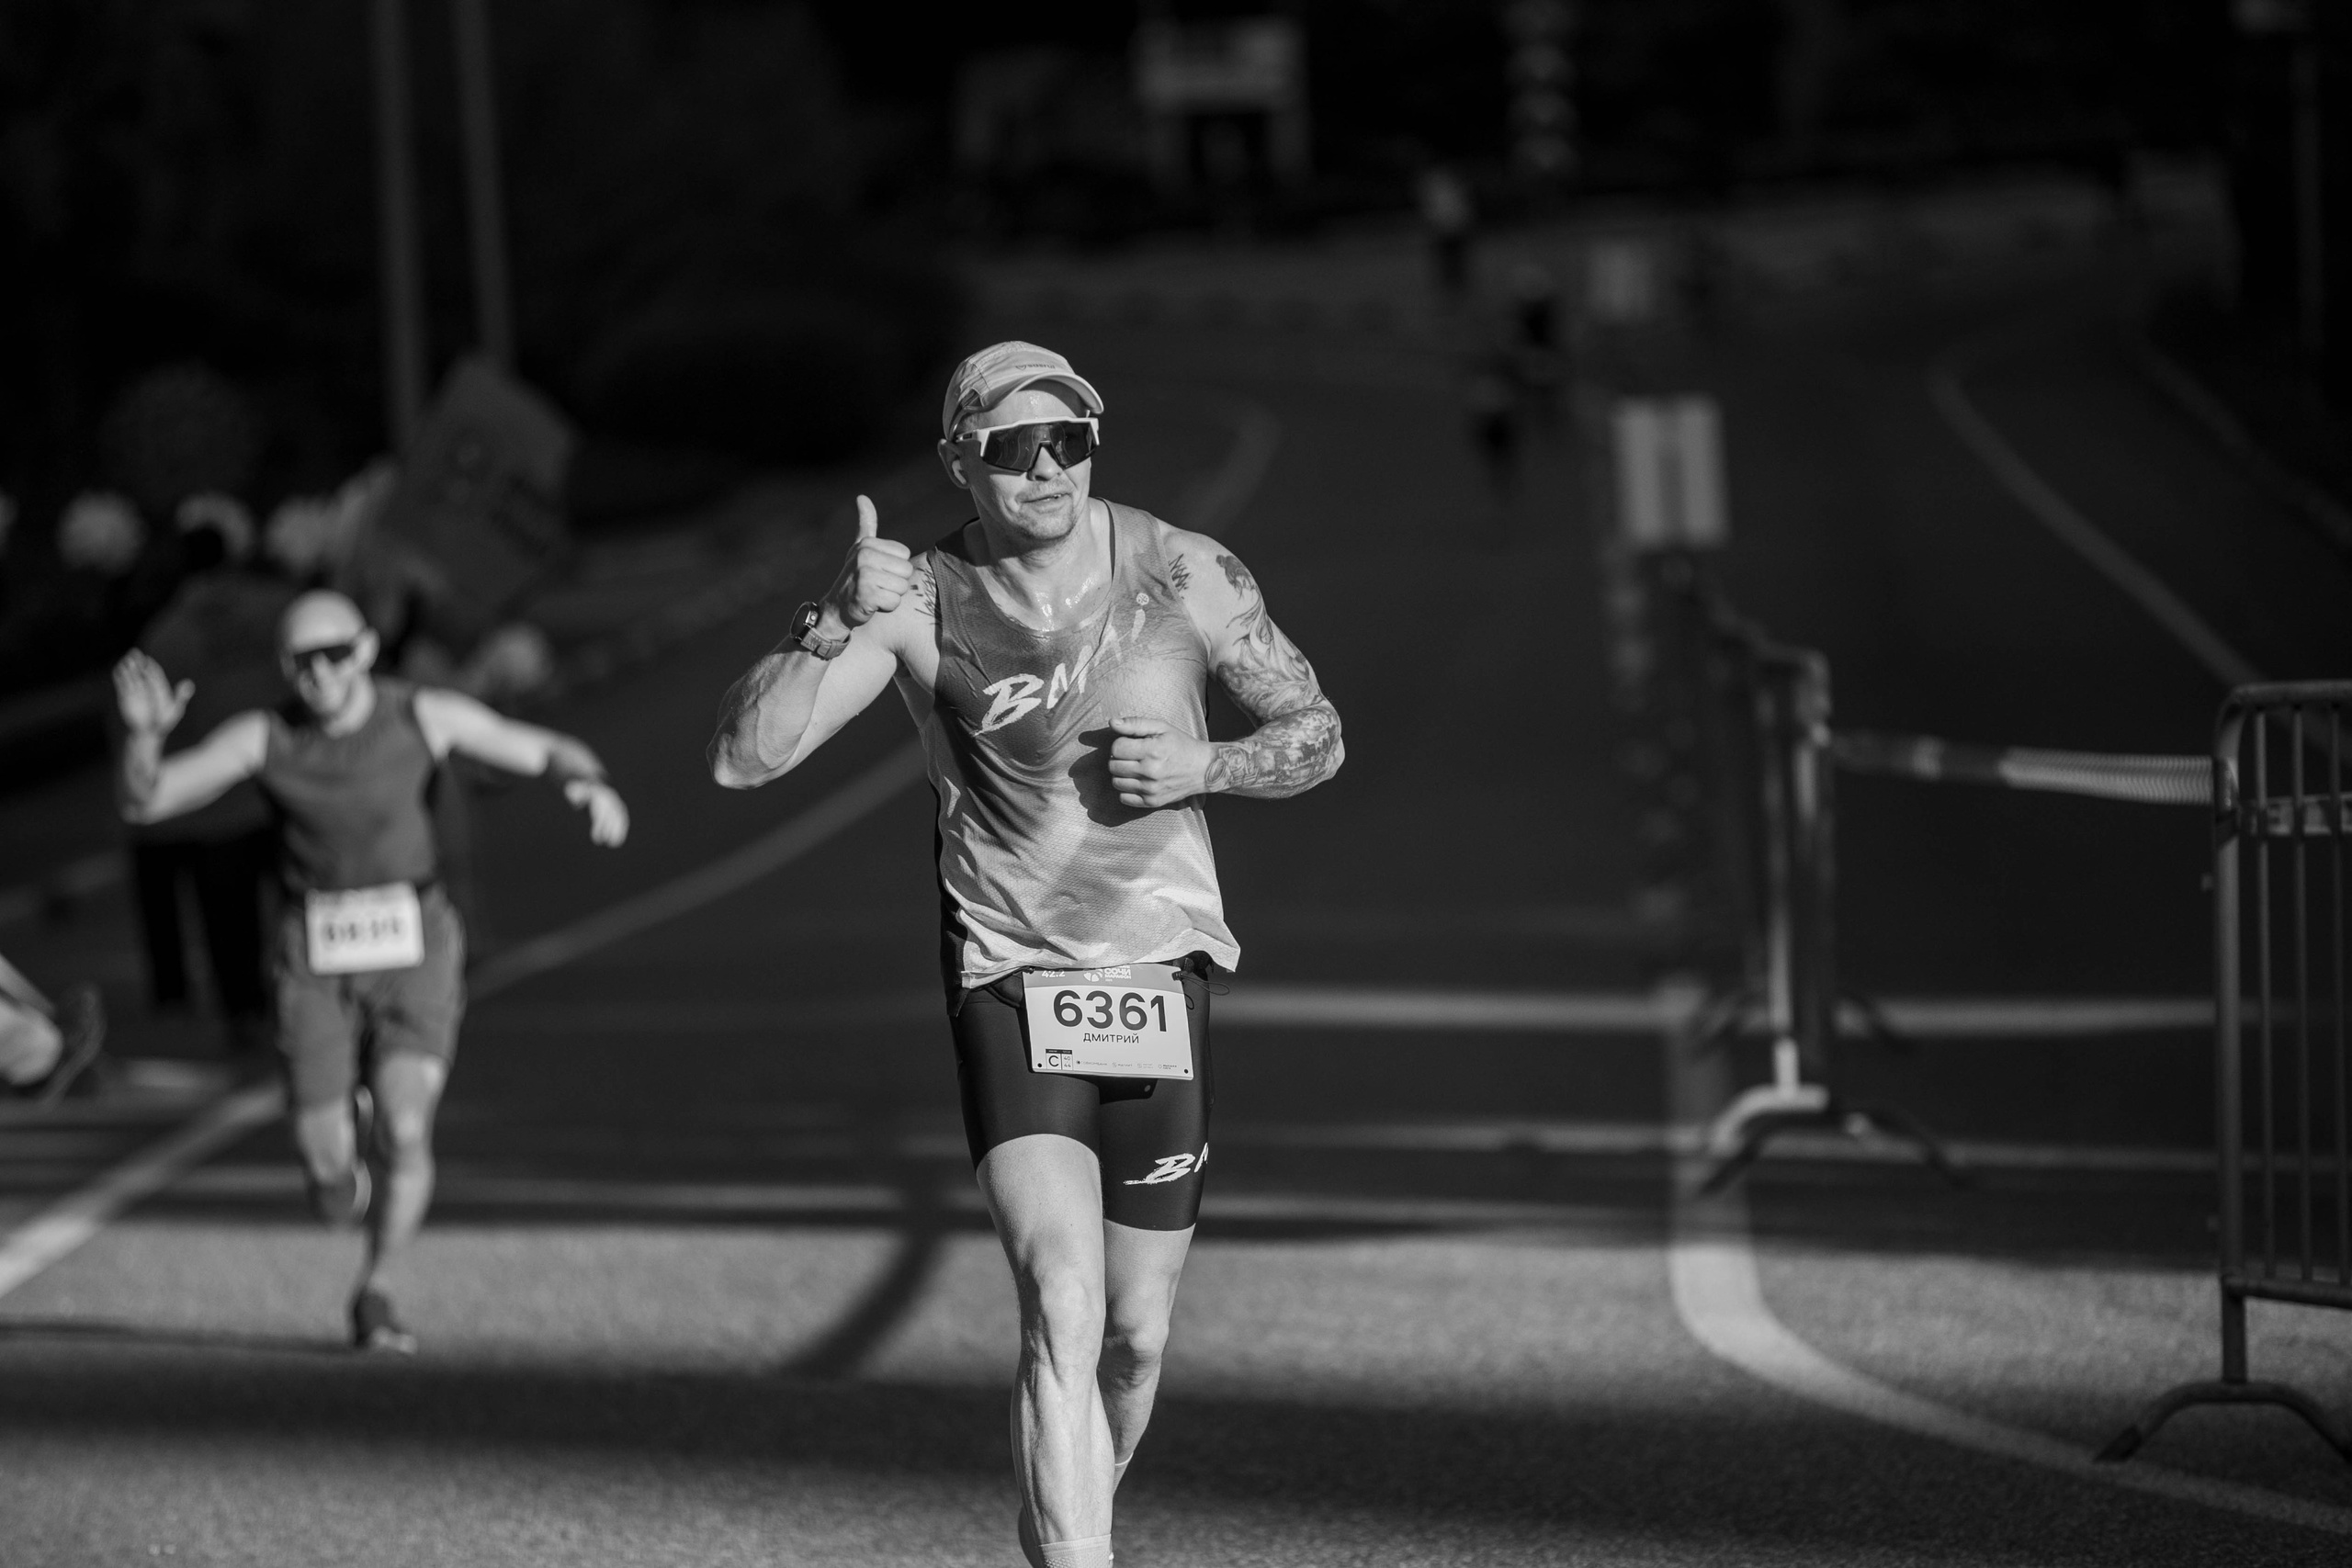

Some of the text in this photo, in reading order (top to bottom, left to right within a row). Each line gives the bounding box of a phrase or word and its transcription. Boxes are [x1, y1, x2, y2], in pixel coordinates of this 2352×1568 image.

[1041, 970, 1066, 978] 42.2
[1104, 967, 1131, 976] СОЧИ
[1053, 989, 1167, 1032] 6361
[1082, 1032, 1139, 1043] ДМИТРИЙ
